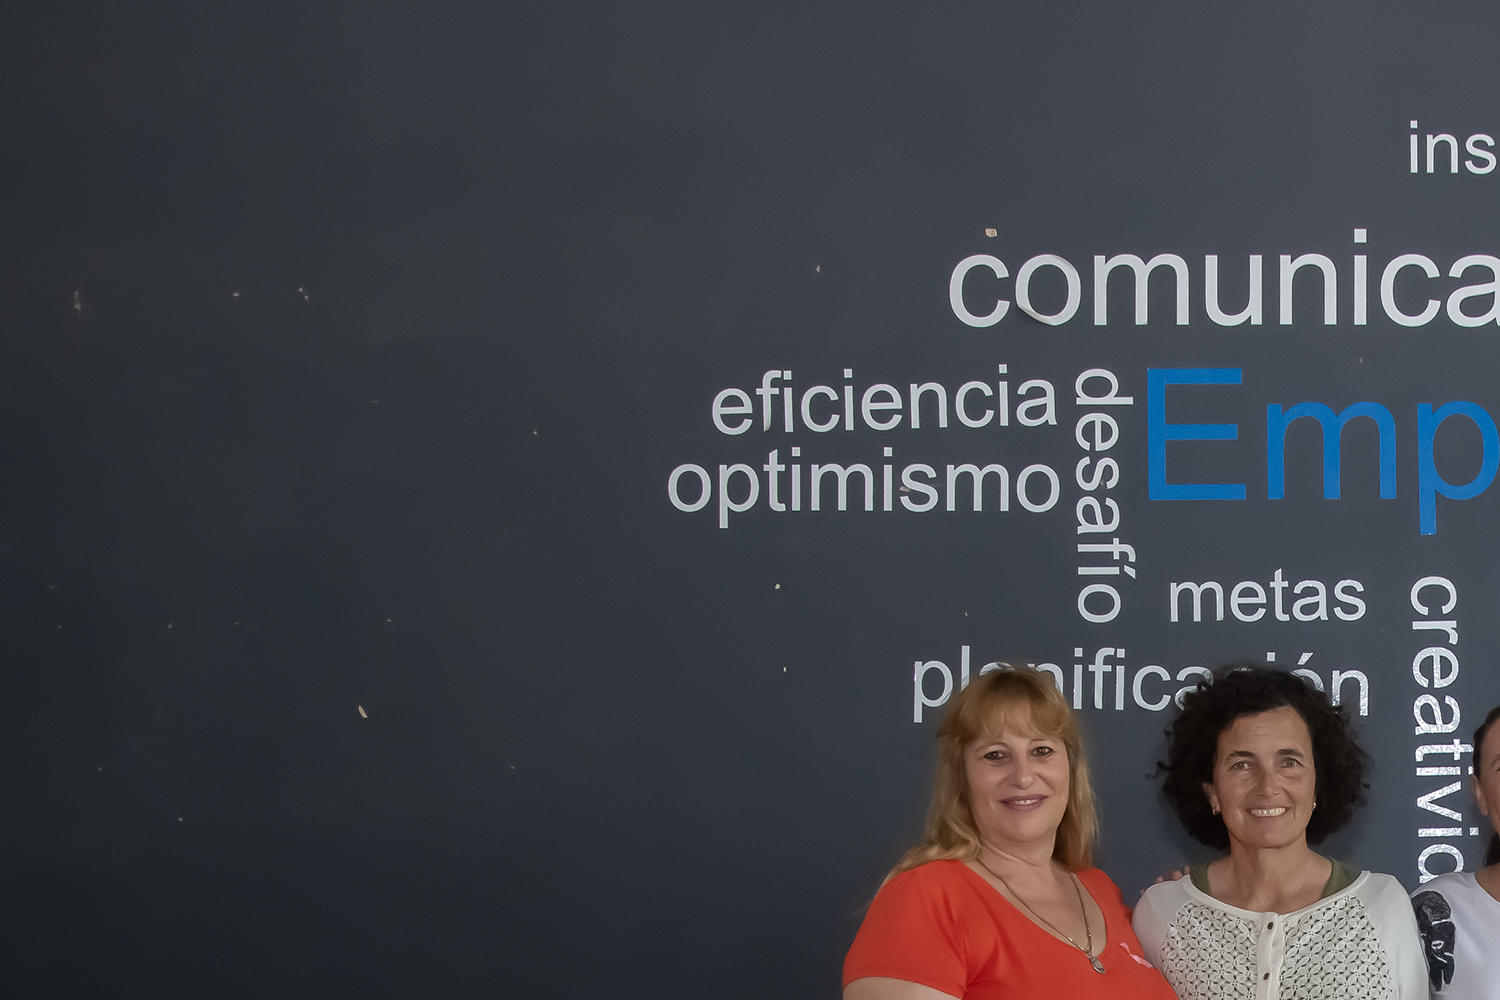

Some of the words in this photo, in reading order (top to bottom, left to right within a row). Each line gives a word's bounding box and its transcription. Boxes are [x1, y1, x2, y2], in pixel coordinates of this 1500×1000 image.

[712, 364, 1058, 436] eficiencia
[667, 447, 1060, 529] optimismo
[1075, 368, 1136, 623] desafío
[1170, 568, 1367, 623] metas
[913, 645, 1369, 723] plificaón
[1410, 576, 1479, 884] creativid
